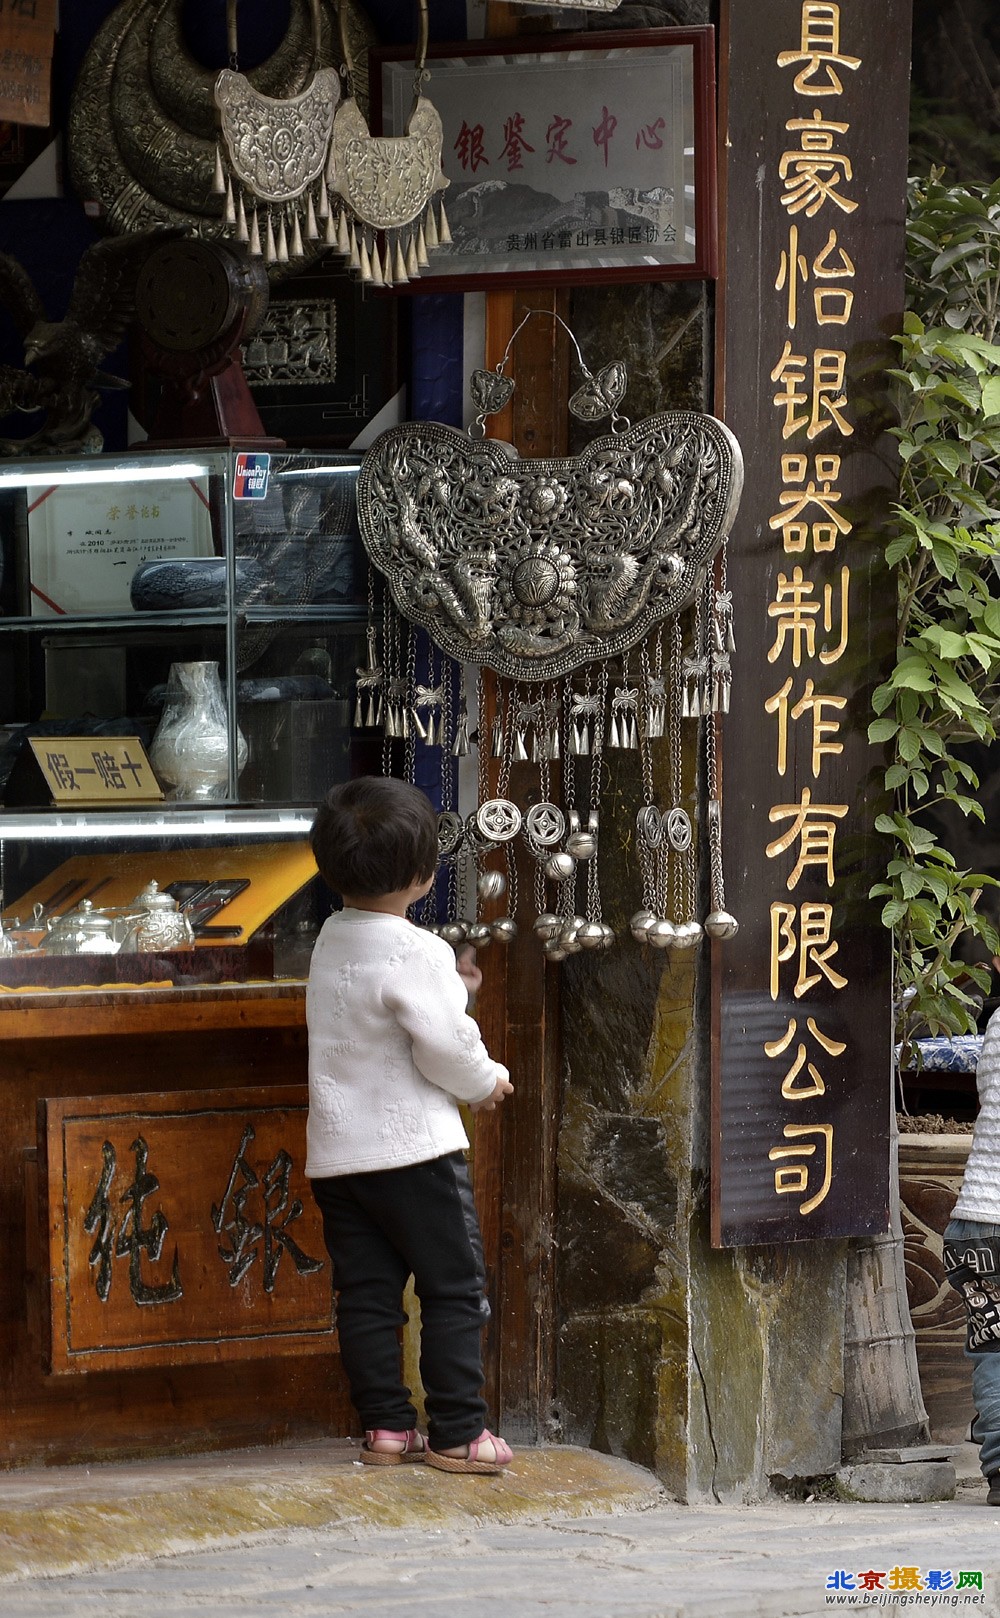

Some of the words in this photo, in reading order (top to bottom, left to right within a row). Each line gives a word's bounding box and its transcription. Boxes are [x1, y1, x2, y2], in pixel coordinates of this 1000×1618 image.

[441, 106, 668, 174] 银鉴定中心
[506, 223, 678, 253] 贵州省雷山县银匠协会
[237, 465, 267, 479] UnionPay
[764, 0, 862, 1216] 县豪怡银器制作有限公司
[46, 751, 144, 791] 假一赔十
